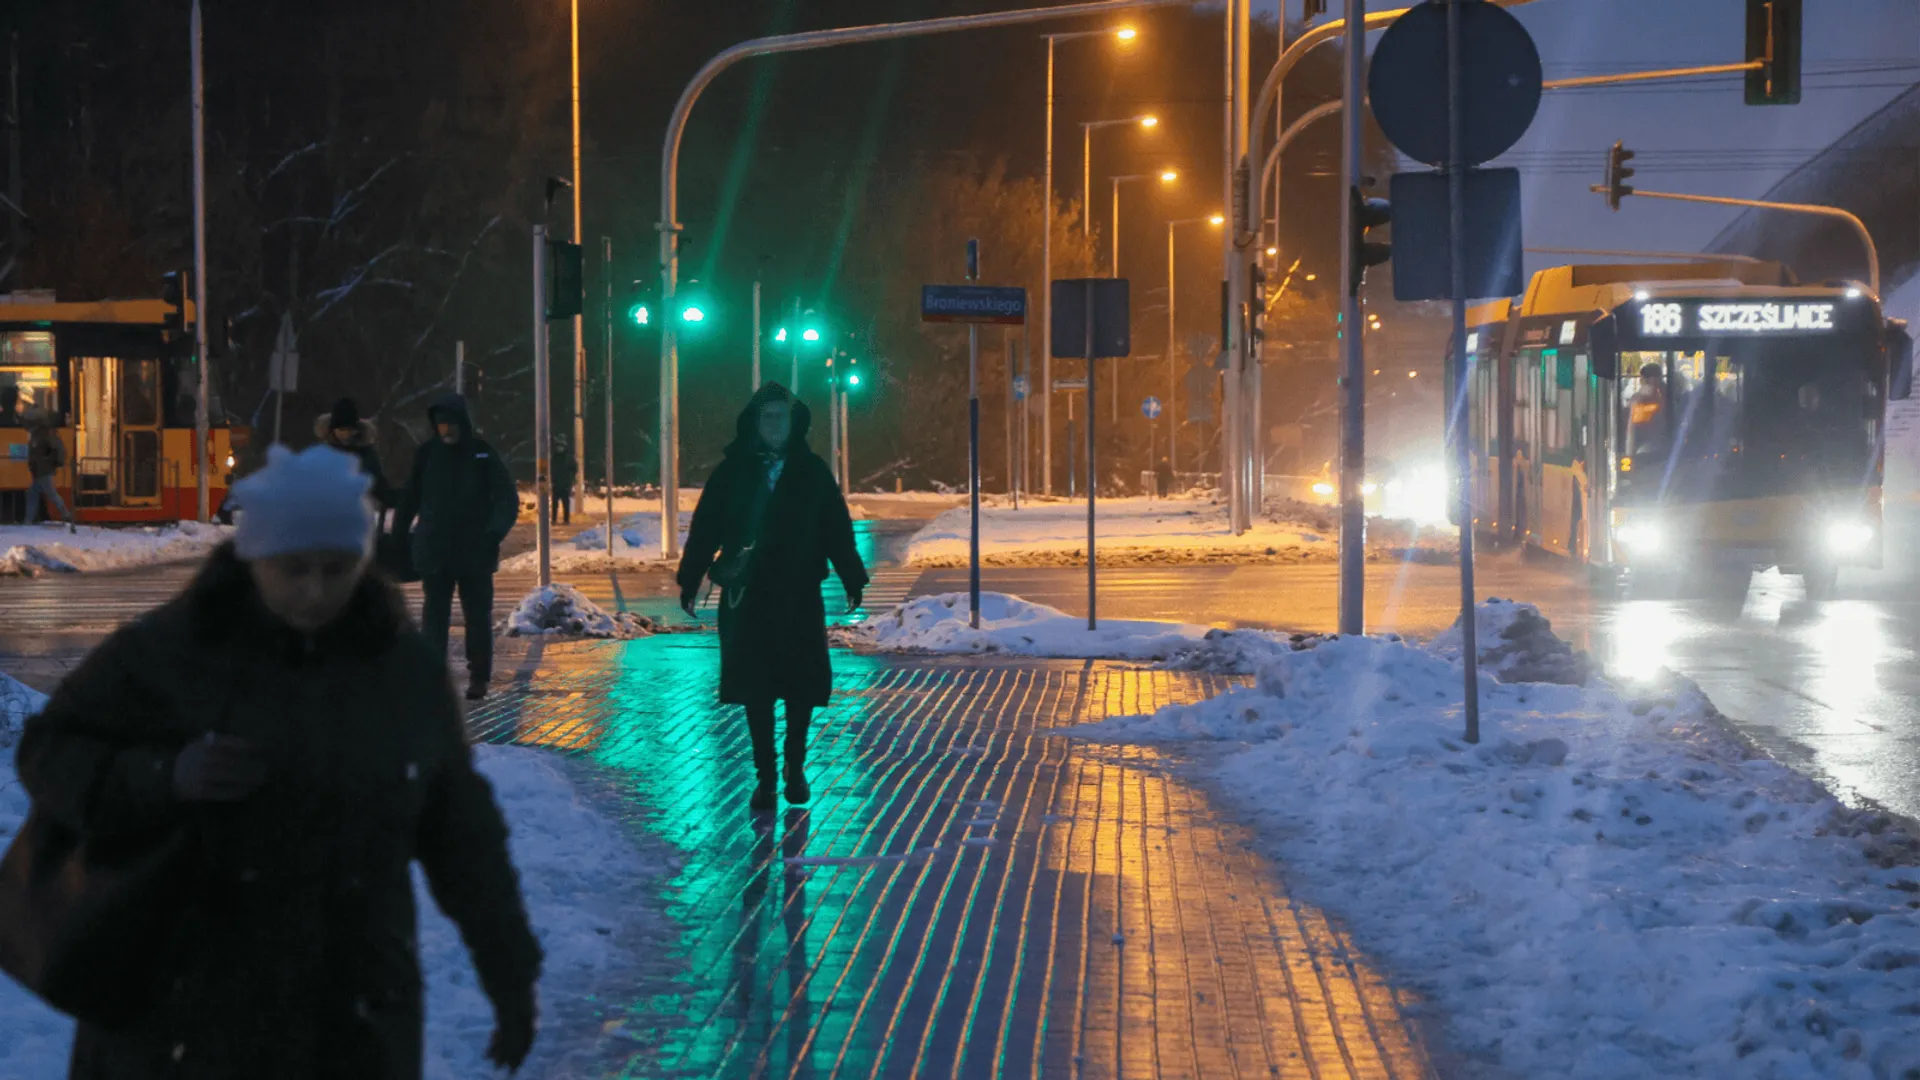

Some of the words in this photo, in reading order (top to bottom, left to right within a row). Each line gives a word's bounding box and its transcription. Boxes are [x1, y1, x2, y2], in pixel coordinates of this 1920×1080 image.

[926, 294, 1021, 316] Broniewskiego
[1640, 303, 1682, 334] 186
[1698, 303, 1833, 331] SZCZĘŚLIWICE
[1620, 456, 1632, 472] 2
